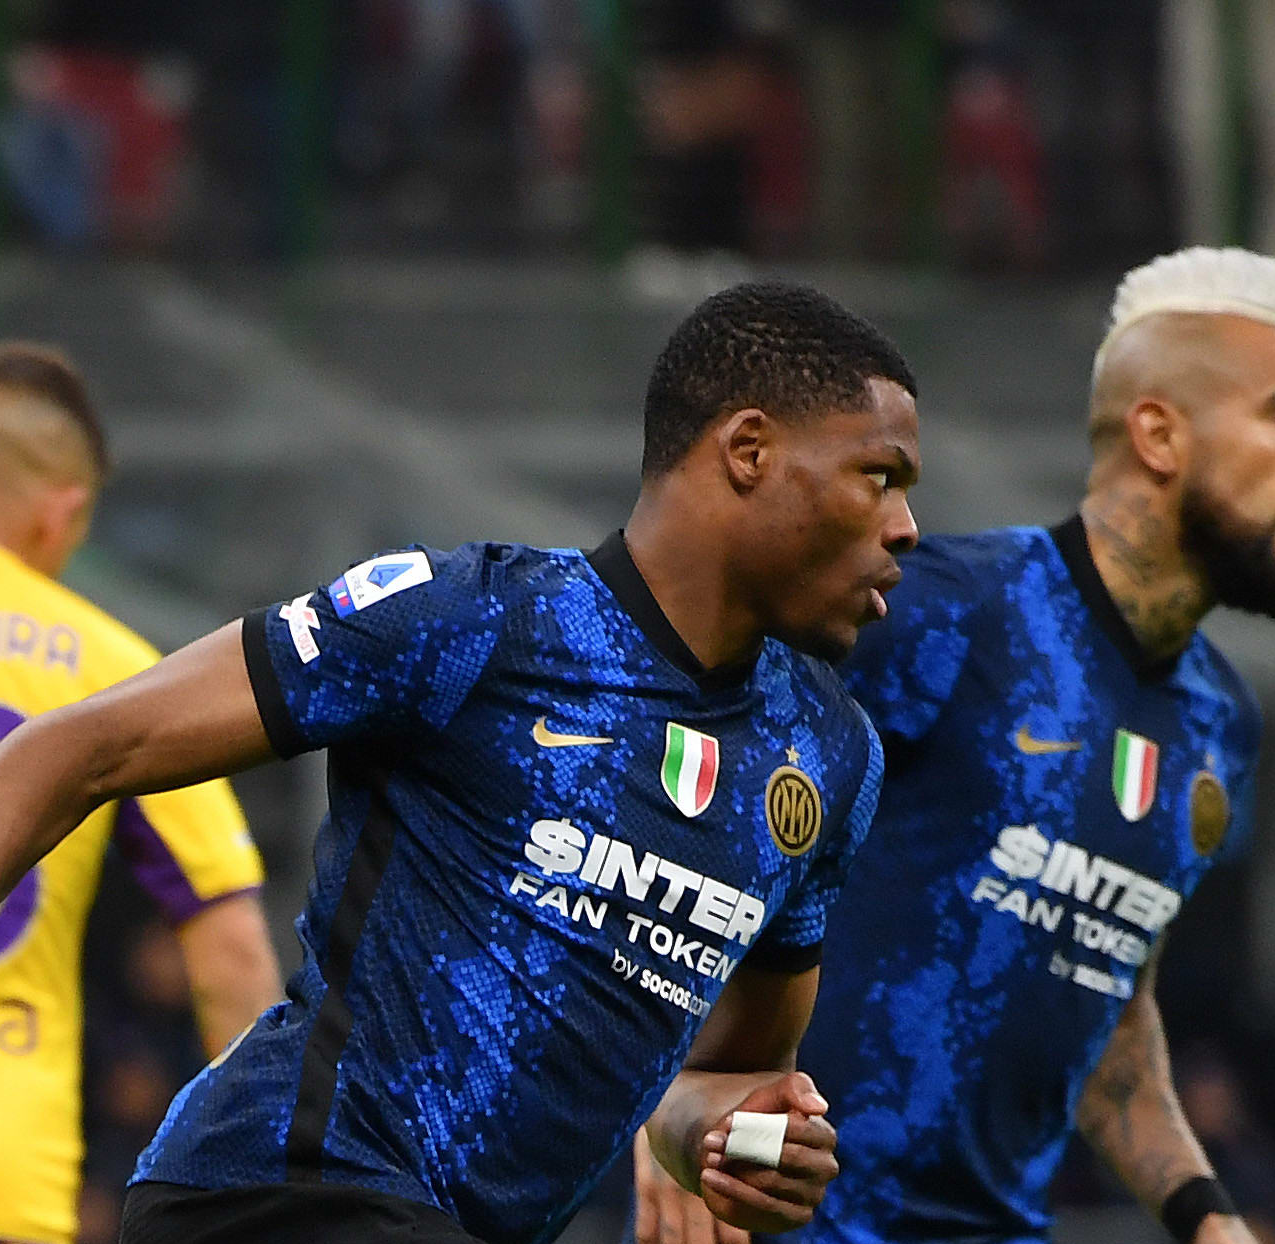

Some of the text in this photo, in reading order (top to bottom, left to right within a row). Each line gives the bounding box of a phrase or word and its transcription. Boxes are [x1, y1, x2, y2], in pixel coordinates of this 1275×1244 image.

[524, 818, 766, 946] $INTER
[972, 876, 1065, 933] FAN
[509, 871, 738, 983] FAN TOKEN
[611, 948, 640, 981] by
